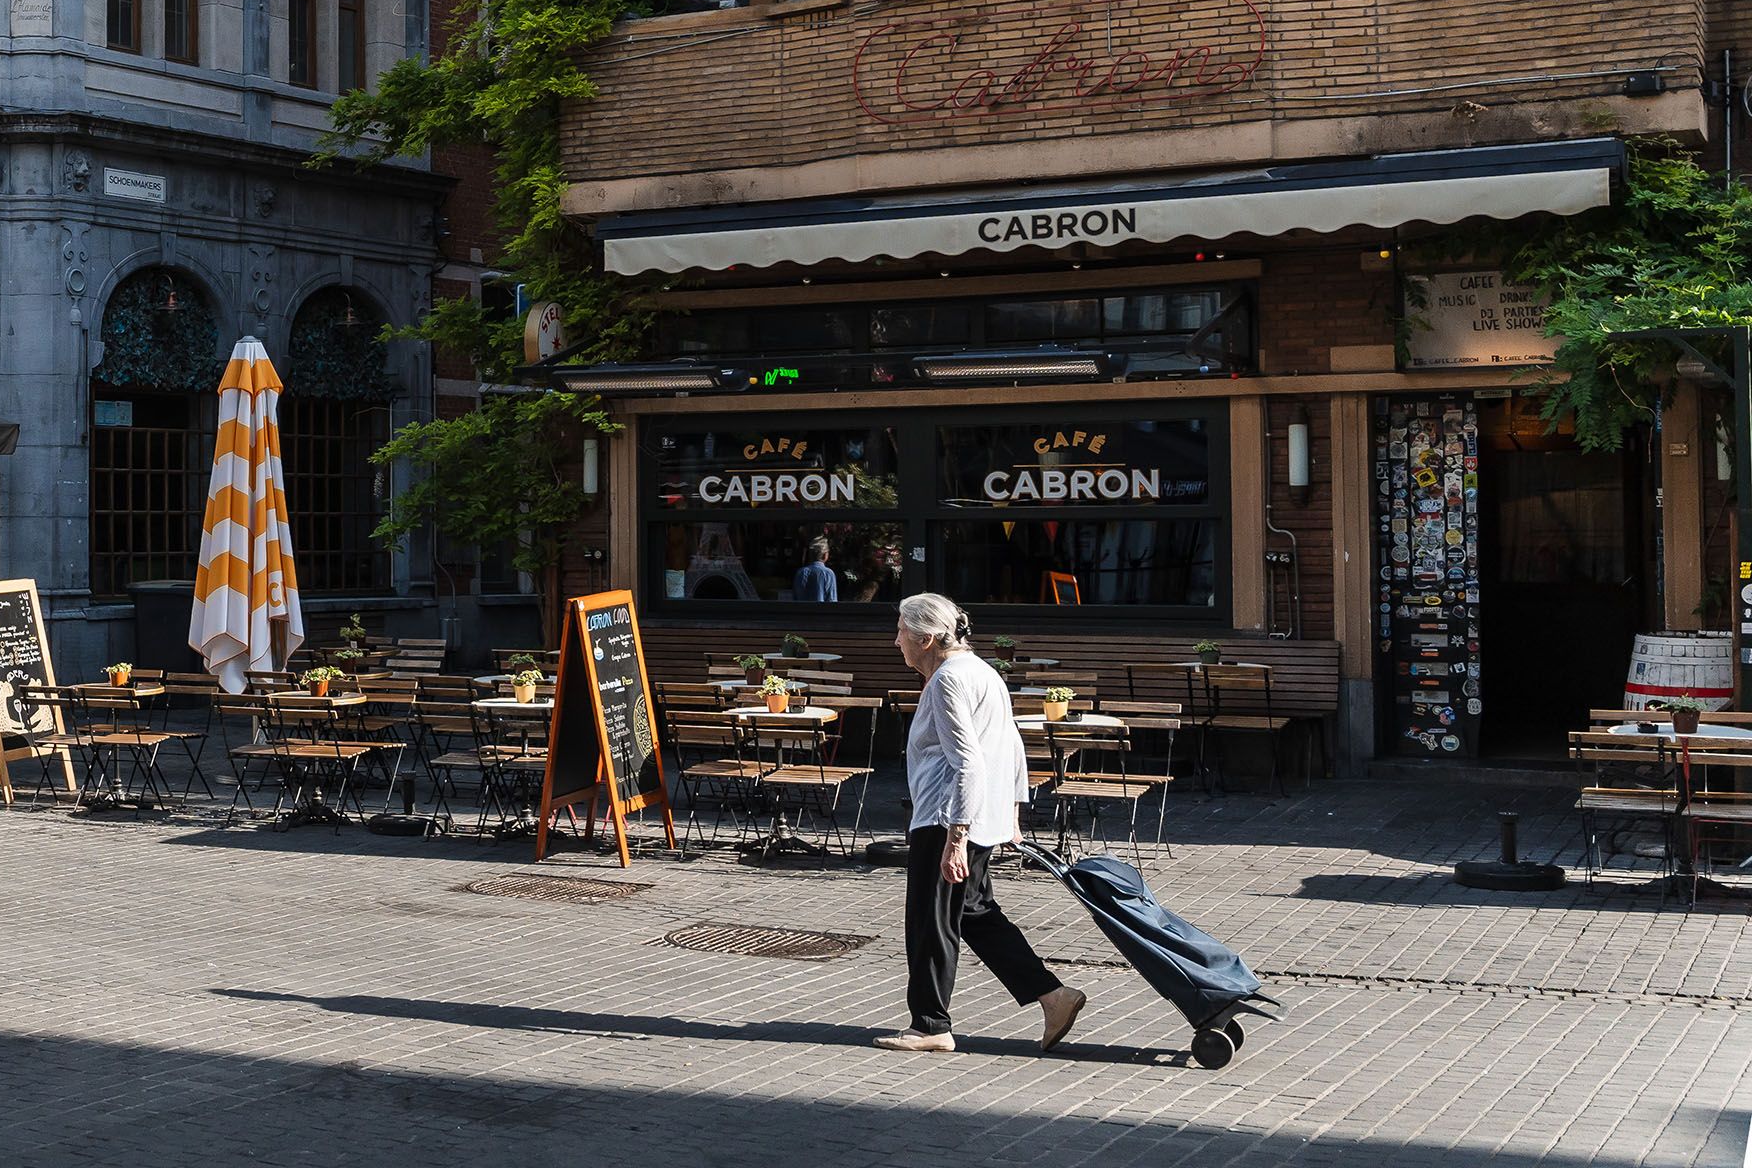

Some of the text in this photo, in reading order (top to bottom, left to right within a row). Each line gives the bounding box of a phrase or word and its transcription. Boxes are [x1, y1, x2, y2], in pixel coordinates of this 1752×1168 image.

[109, 175, 161, 190] SCHOENMAKERS
[978, 207, 1136, 243] CABRON
[1438, 293, 1477, 307] MUSIC
[1480, 305, 1545, 319] DJ PARTIES
[1472, 319, 1501, 332] LIVE
[743, 437, 808, 460] CAFÉ
[1033, 430, 1106, 455] CAFÉ
[698, 473, 855, 503] CABRON
[983, 468, 1160, 500] CABRON
